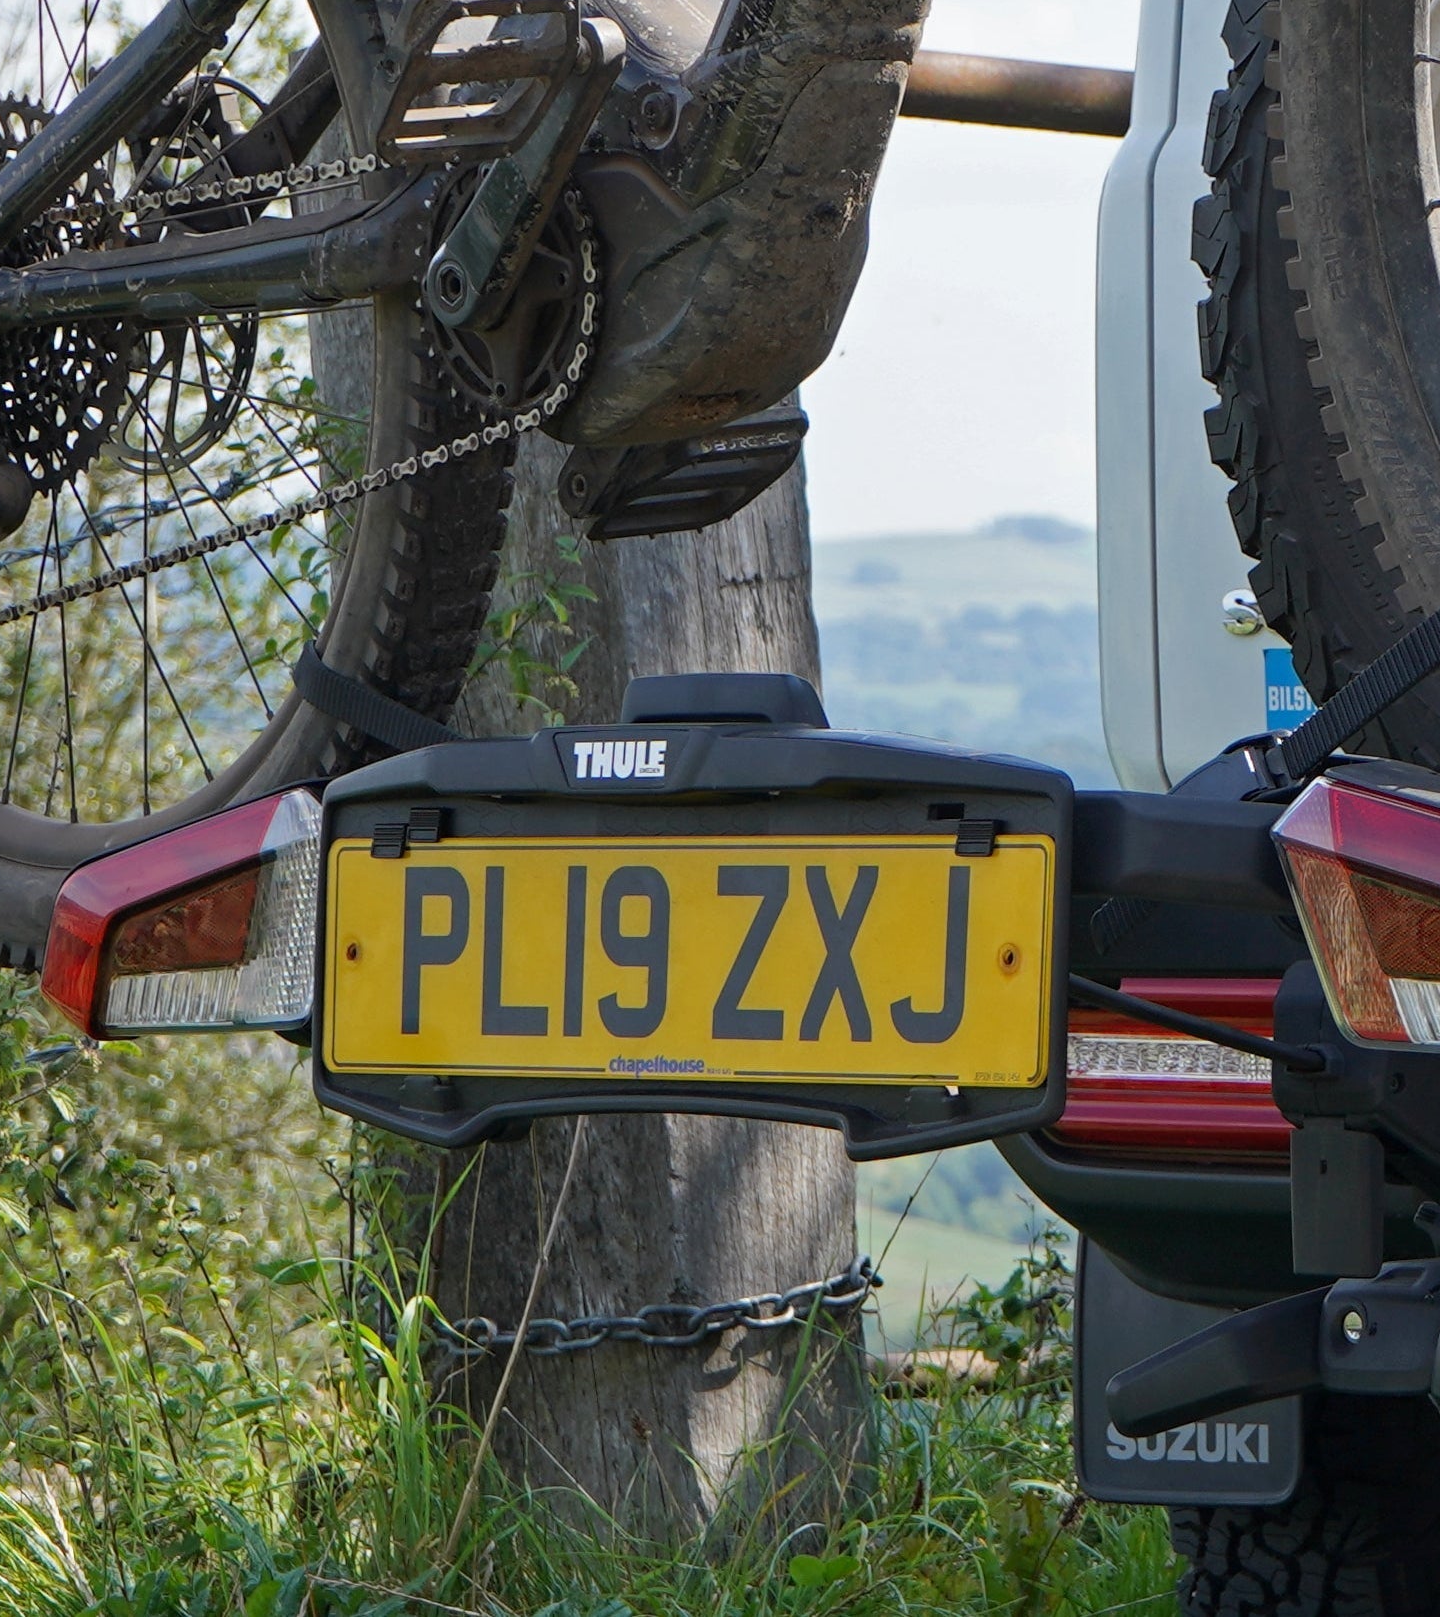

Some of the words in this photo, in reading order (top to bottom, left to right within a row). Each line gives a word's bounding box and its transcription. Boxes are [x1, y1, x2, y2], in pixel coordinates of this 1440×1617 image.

[573, 740, 667, 779] THULE
[401, 866, 671, 1038] PL19
[711, 866, 970, 1043] ZXJ
[609, 1054, 705, 1078] chapelhouse
[1106, 1420, 1269, 1464] SUZUKI
